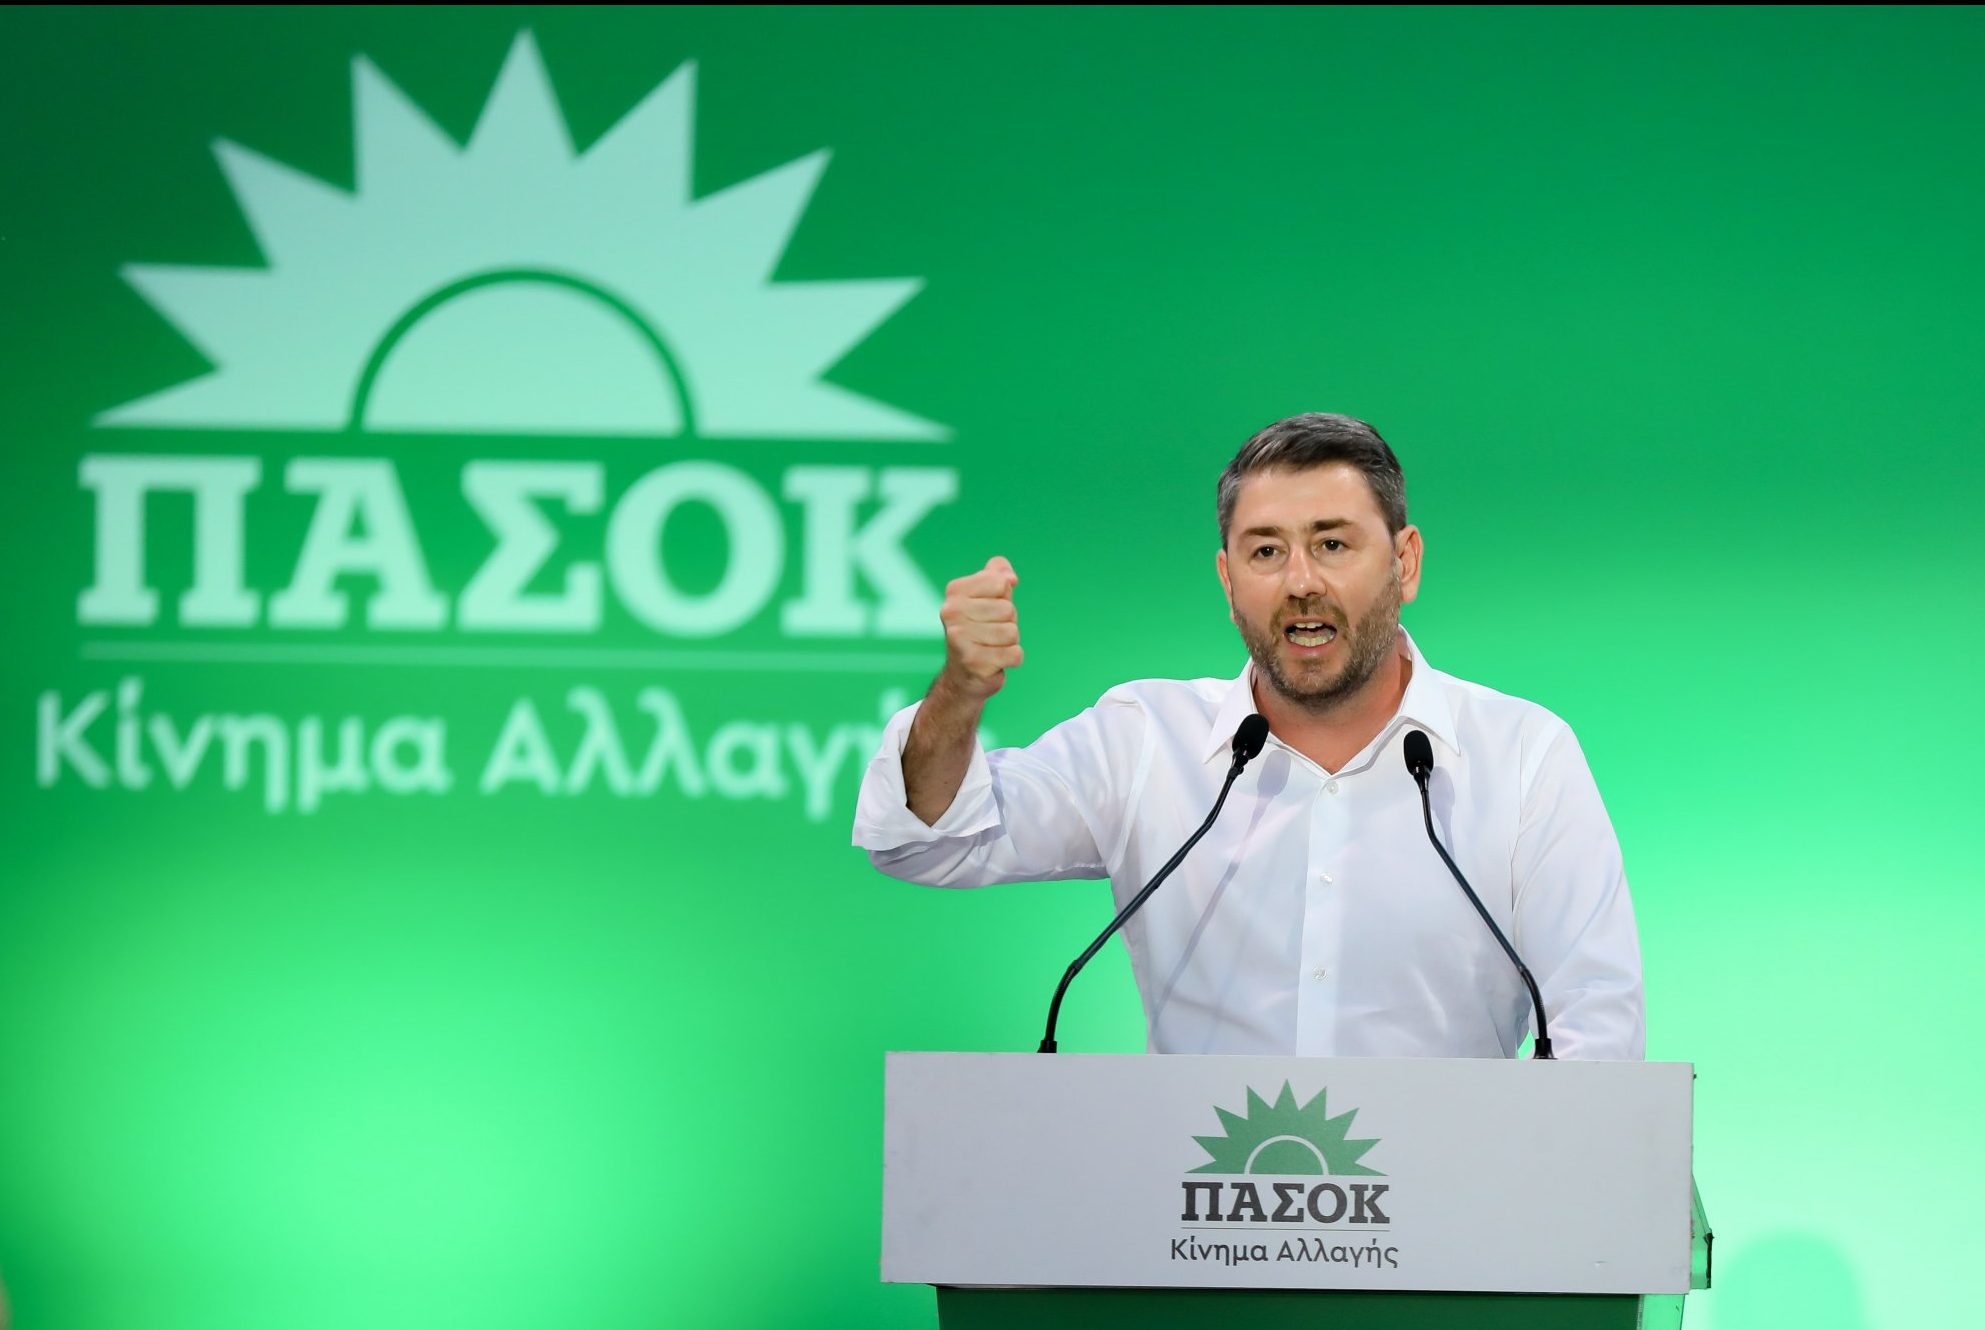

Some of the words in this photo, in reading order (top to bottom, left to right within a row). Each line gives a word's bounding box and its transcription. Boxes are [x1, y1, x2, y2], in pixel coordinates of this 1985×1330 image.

[76, 455, 959, 638] ΠΑΣΟΚ
[35, 676, 453, 814] Κίνημα
[1181, 1181, 1391, 1224] ΠΑΣΟΚ
[1170, 1235, 1269, 1267] Κίνημα
[1276, 1237, 1399, 1269] Αλλαγής
